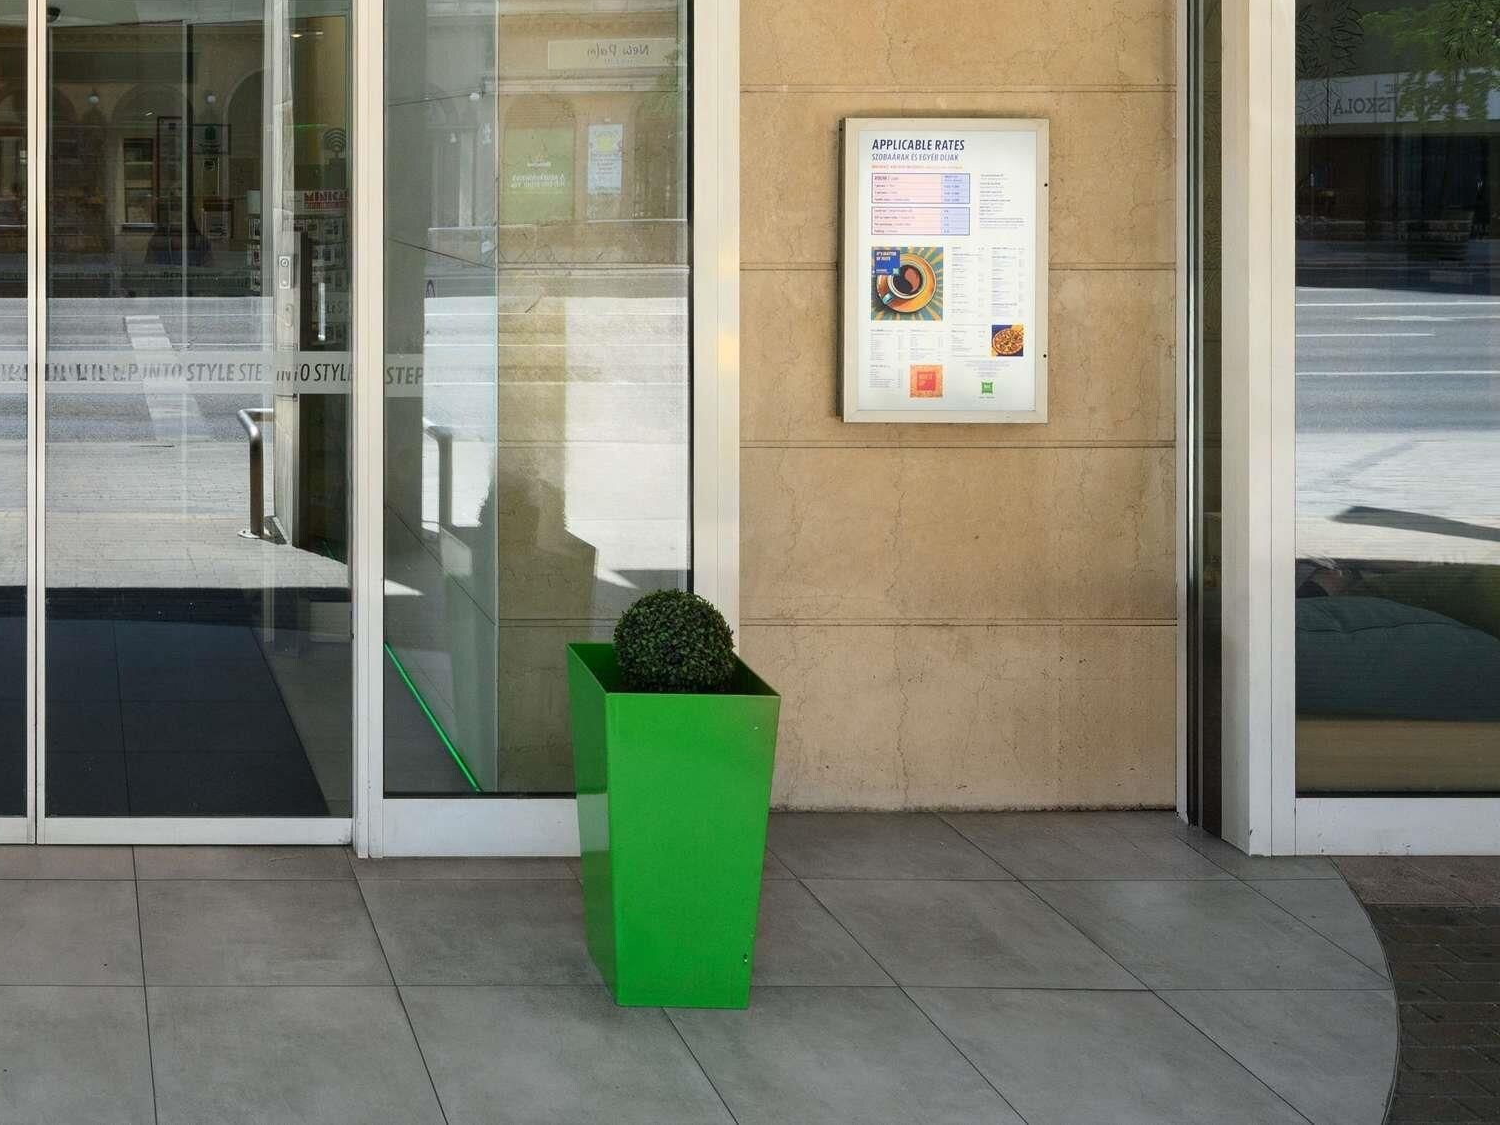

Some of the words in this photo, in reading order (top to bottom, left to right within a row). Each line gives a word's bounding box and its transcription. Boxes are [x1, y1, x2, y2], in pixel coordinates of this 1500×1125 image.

[872, 139, 932, 151] APPLICABLE
[934, 139, 965, 151] RATES
[184, 363, 234, 382] STYLE
[385, 366, 424, 386] STEP
